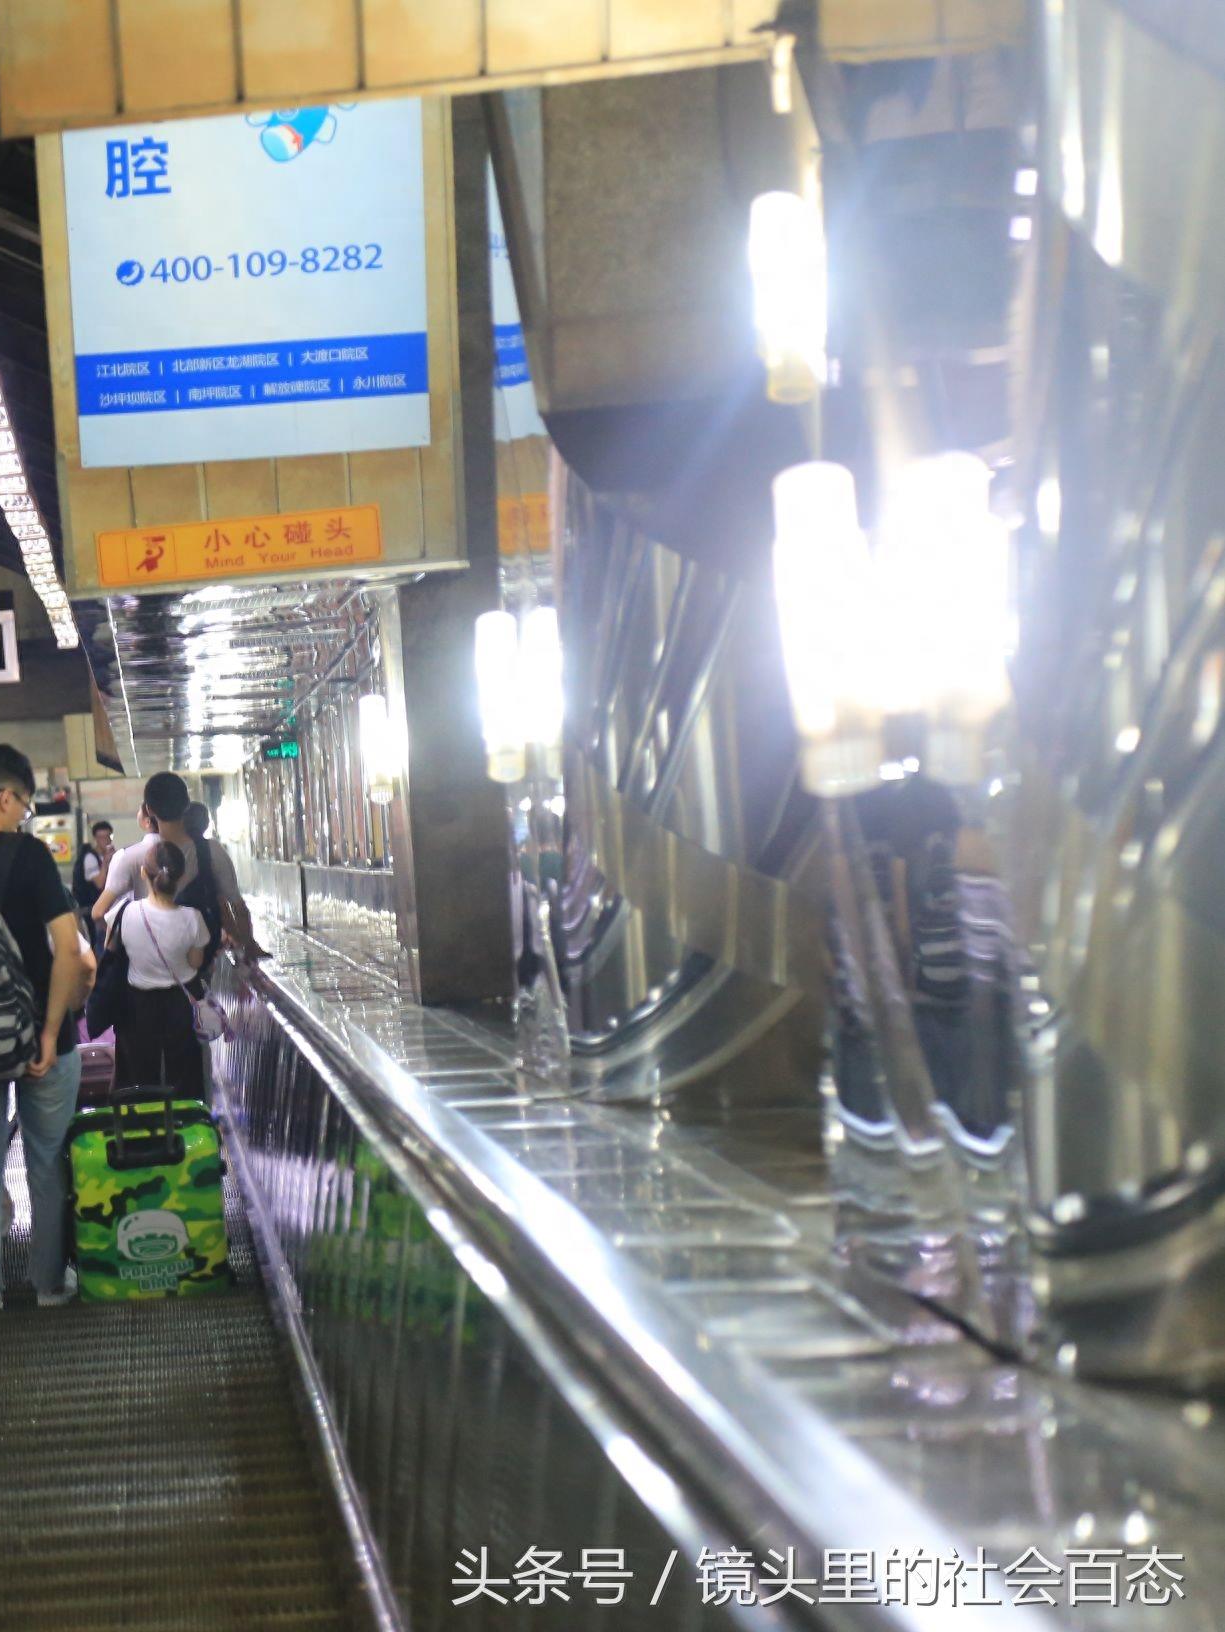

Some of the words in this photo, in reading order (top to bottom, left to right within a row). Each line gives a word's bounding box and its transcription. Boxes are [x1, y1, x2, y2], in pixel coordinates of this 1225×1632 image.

[105, 136, 171, 198] 腔
[150, 243, 384, 283] 400-109-8282
[204, 516, 352, 552] 小心碰头
[205, 554, 244, 569] Mind
[259, 551, 297, 565] Your
[310, 545, 355, 560] Head
